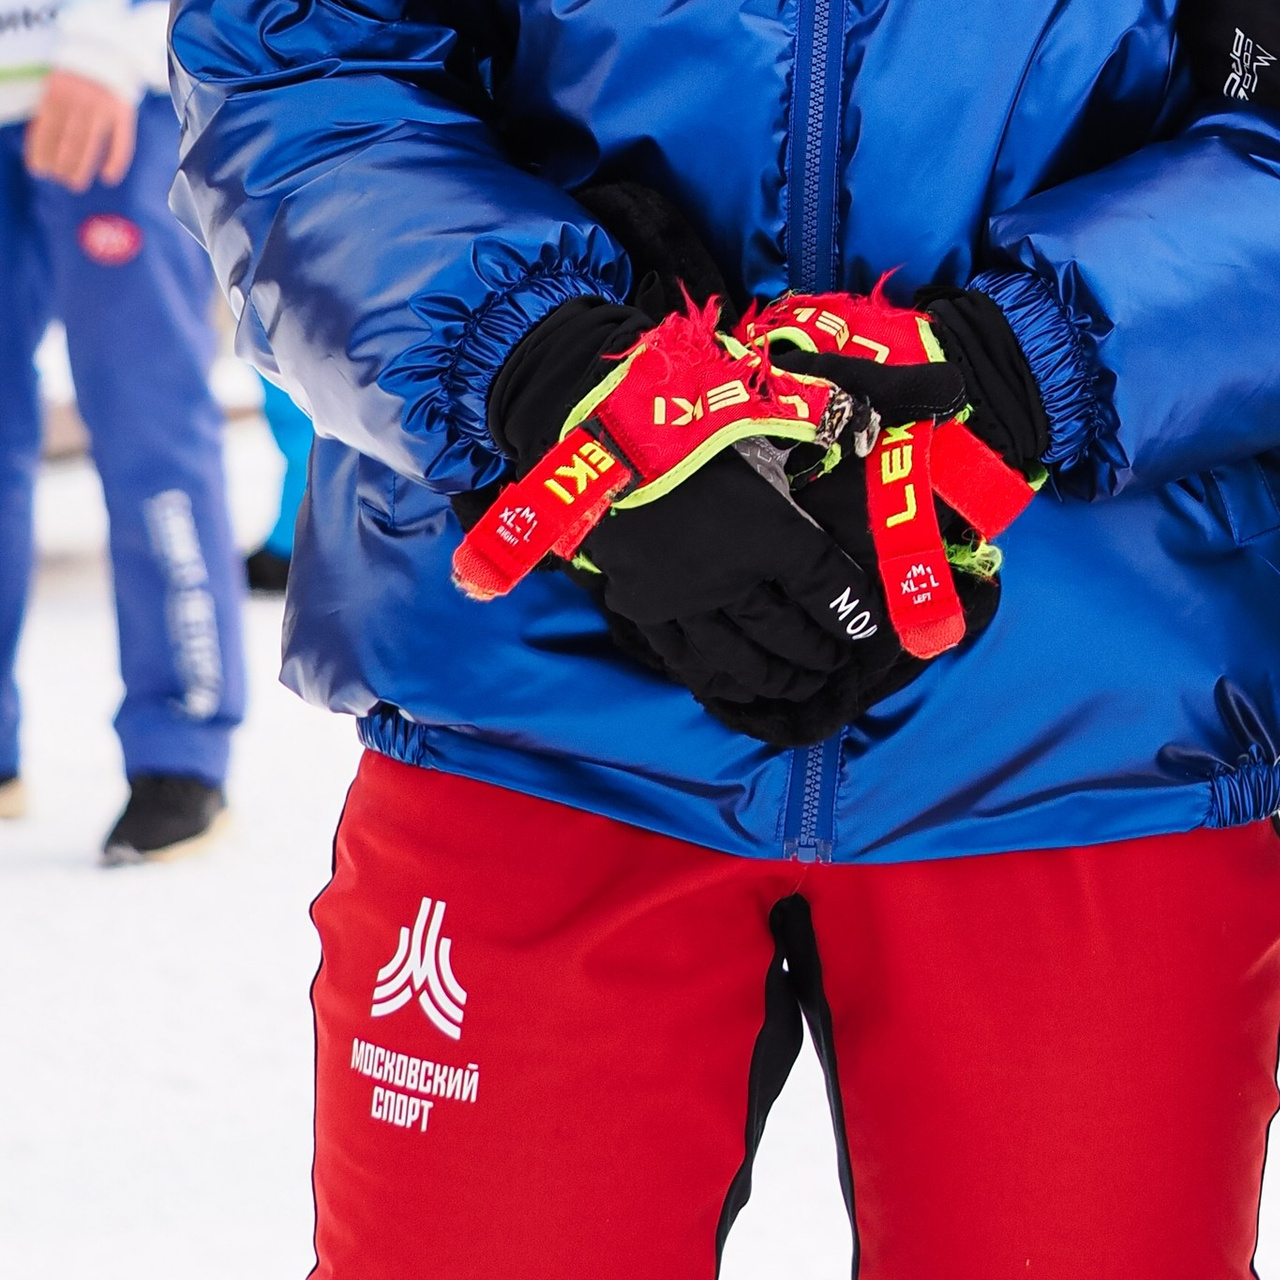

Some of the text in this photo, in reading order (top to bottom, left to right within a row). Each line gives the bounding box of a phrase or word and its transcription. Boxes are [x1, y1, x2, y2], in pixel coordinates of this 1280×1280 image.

[543, 440, 616, 505] EKI
[912, 591, 932, 605] LEFT
[350, 1037, 480, 1104] МОСКОВСКИЙ
[370, 1085, 434, 1133] СПОРТ
